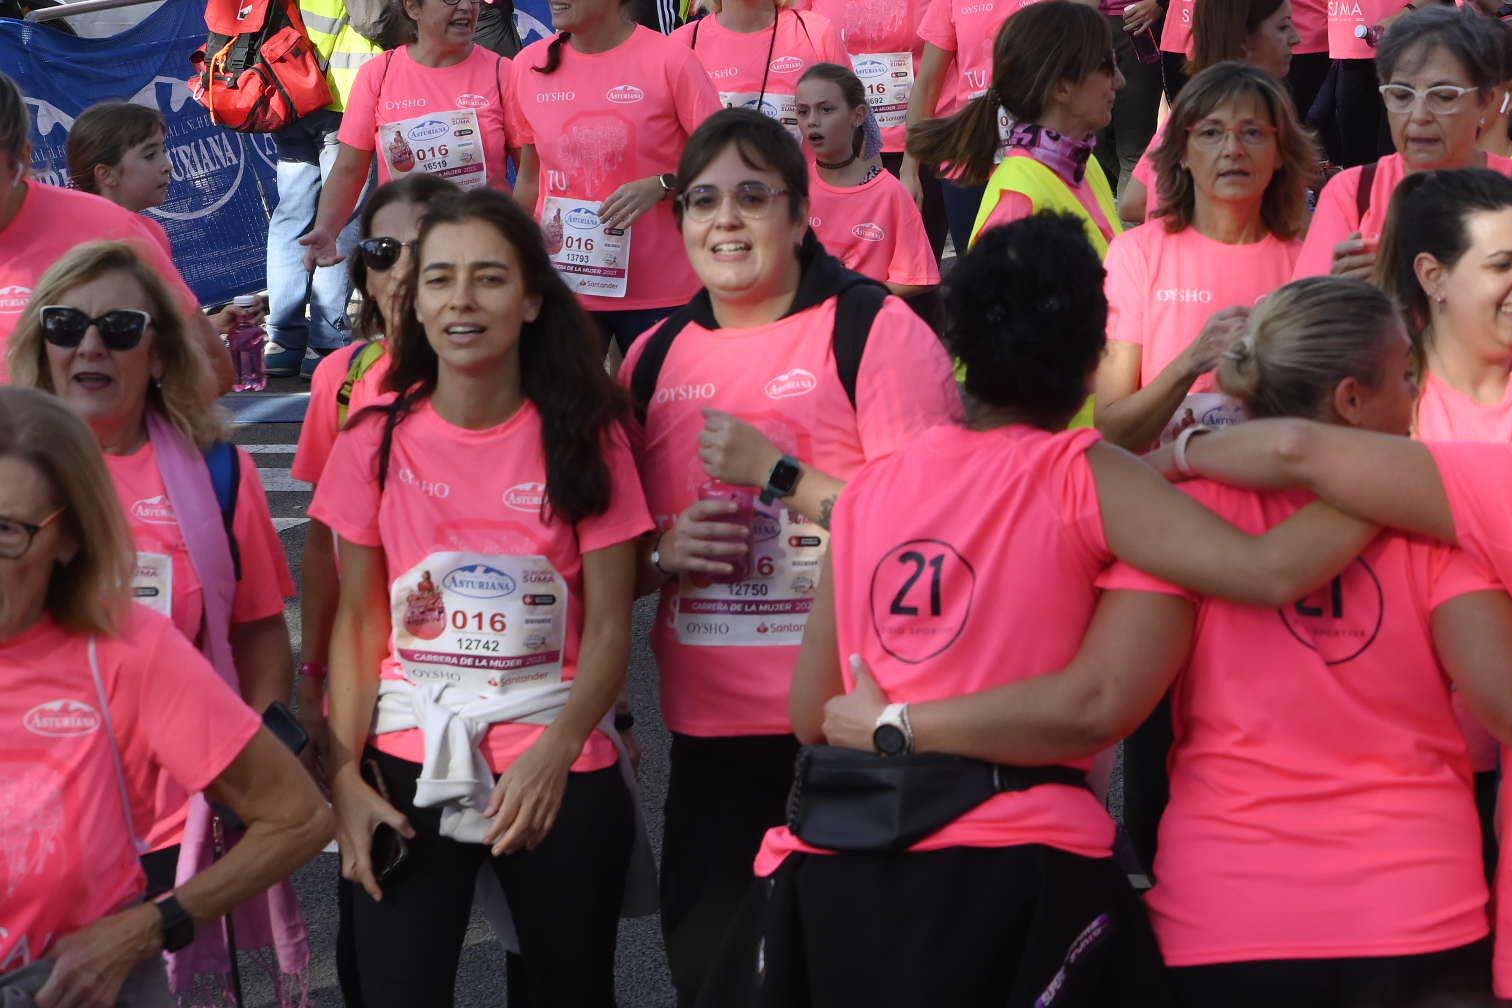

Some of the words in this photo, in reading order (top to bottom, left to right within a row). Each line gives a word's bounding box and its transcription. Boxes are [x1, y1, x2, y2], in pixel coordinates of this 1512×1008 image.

[960, 3, 994, 15] OYSHO
[707, 66, 739, 80] YSHO
[964, 70, 987, 89] TU
[867, 83, 886, 94] 16
[385, 98, 426, 110] OYSHO
[536, 91, 575, 104] OYSHO
[168, 131, 239, 182] URIANA
[416, 144, 449, 161] 016
[423, 160, 448, 171] 16519
[547, 169, 567, 192] TU
[565, 235, 594, 252] 016
[566, 253, 590, 264] 13793
[587, 280, 618, 290] Santander
[1157, 289, 1211, 303] OYSHO
[657, 383, 717, 404] OYSHO
[451, 575, 511, 591] ASTURIANA
[522, 575, 555, 583] SUMA
[889, 551, 945, 617] 21
[728, 584, 768, 596] 12750
[729, 601, 742, 611] DE
[744, 601, 757, 611] LA
[759, 601, 792, 611] MUJER
[452, 610, 507, 633] 016
[686, 622, 729, 635] OYSHO
[770, 622, 806, 634] Santan
[457, 638, 500, 652] 12742
[413, 653, 458, 665] CARRERA
[460, 657, 473, 666] DE
[475, 657, 488, 666] LA
[489, 658, 522, 668] MUJER
[412, 668, 461, 683] OYSHO
[500, 671, 549, 688] Santander
